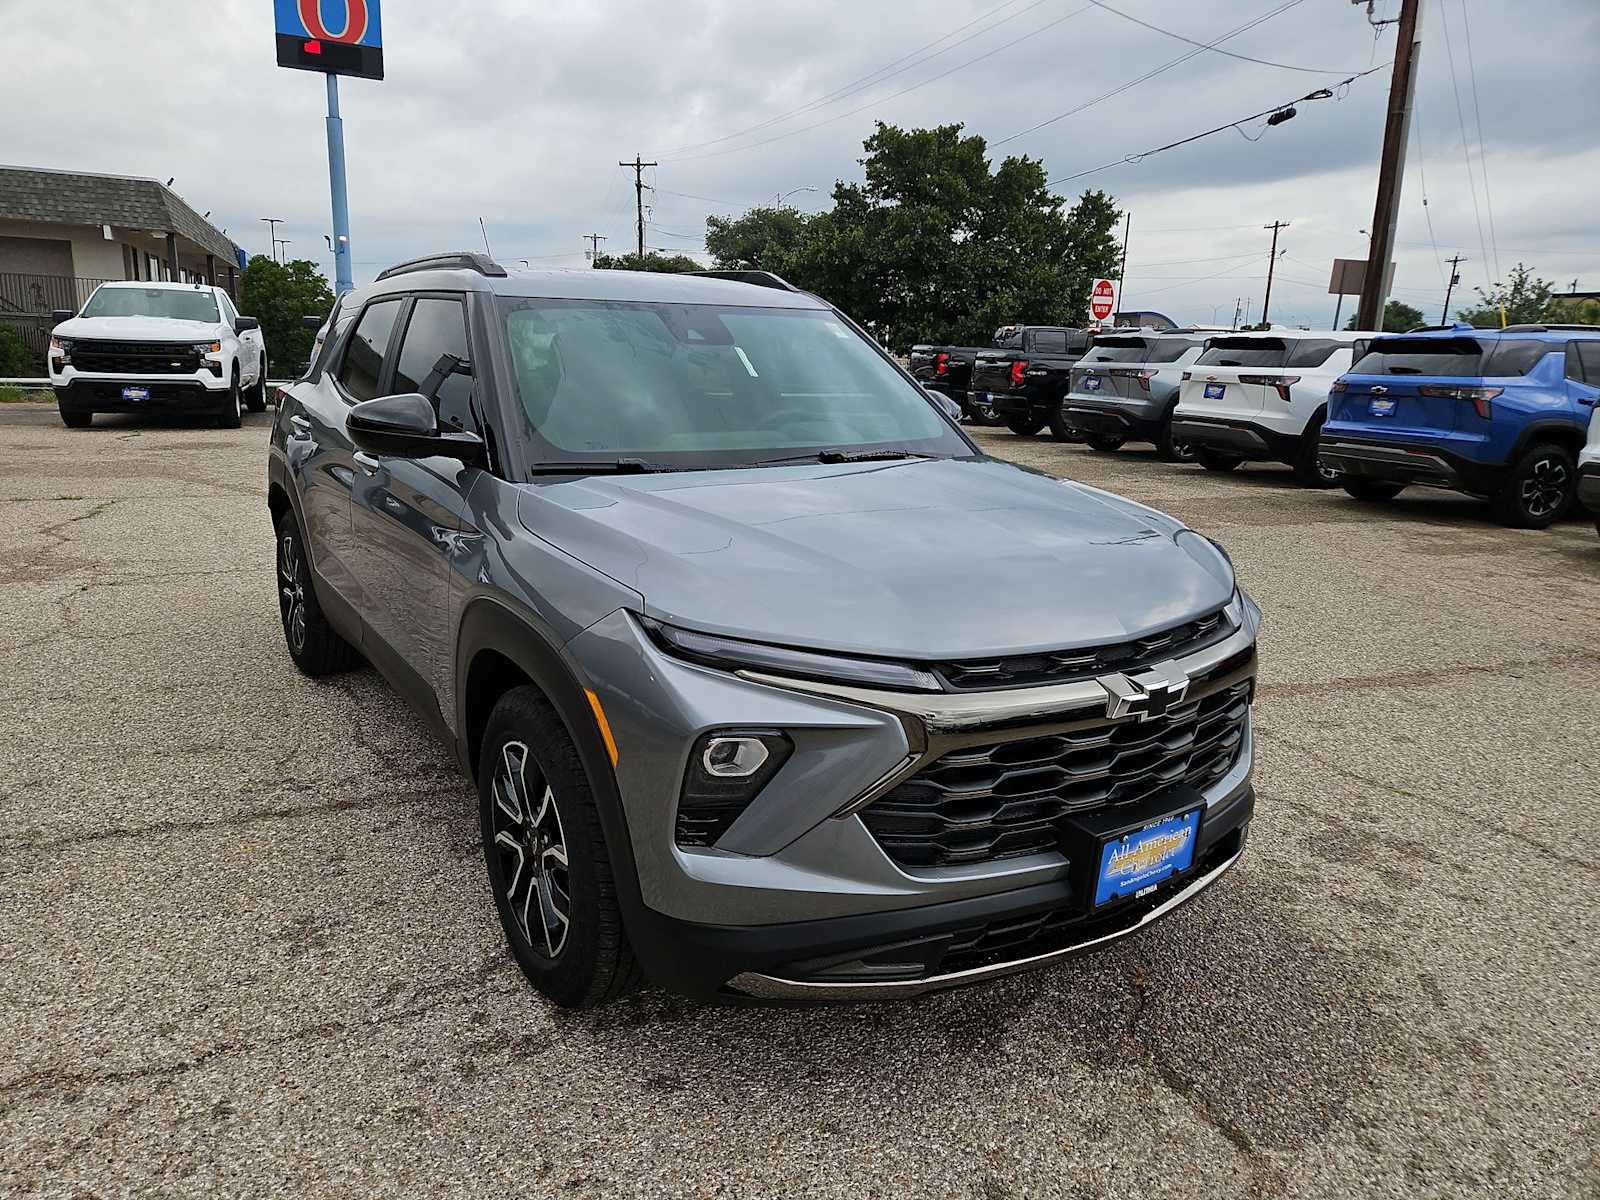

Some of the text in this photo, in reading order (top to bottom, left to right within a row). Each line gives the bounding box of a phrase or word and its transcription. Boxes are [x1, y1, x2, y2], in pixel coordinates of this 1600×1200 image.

[1095, 305, 1109, 313] ENTER
[1108, 826, 1192, 865] All American
